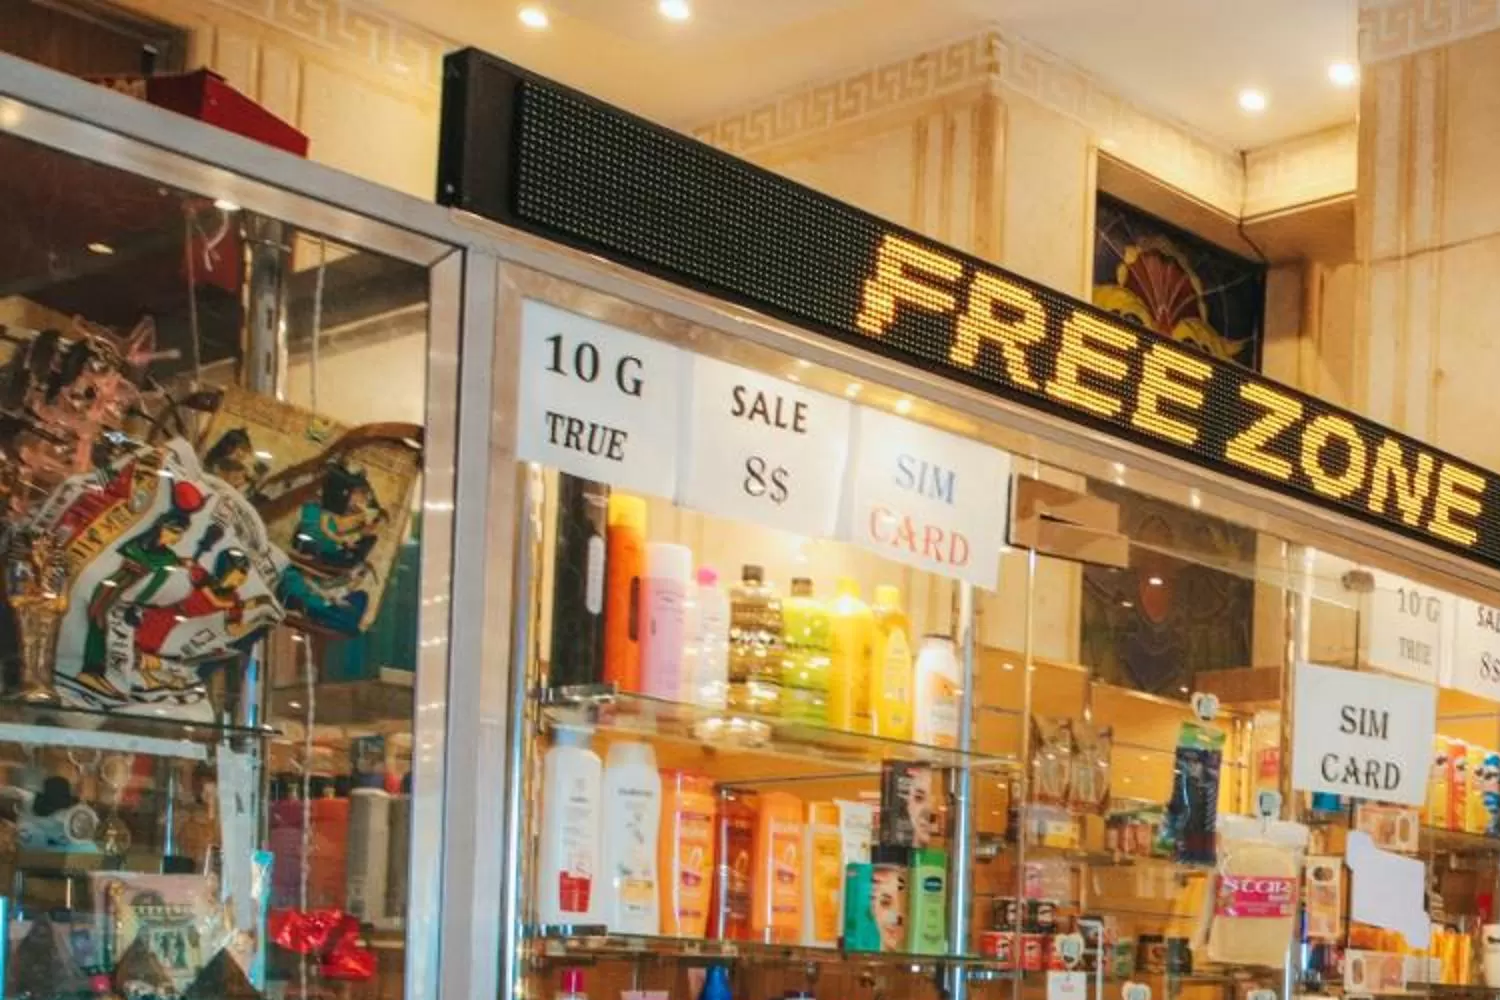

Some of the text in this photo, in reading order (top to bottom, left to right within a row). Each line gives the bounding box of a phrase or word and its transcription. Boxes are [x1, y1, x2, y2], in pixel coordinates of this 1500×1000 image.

[545, 334, 646, 398] 10 G
[855, 234, 1487, 547] FREE ZONE
[731, 384, 809, 434] SALE
[544, 410, 628, 462] TRUE
[895, 453, 957, 505] SIM
[869, 506, 971, 568] CARD
[1338, 704, 1389, 740] SIM
[1320, 752, 1401, 792] CARD
